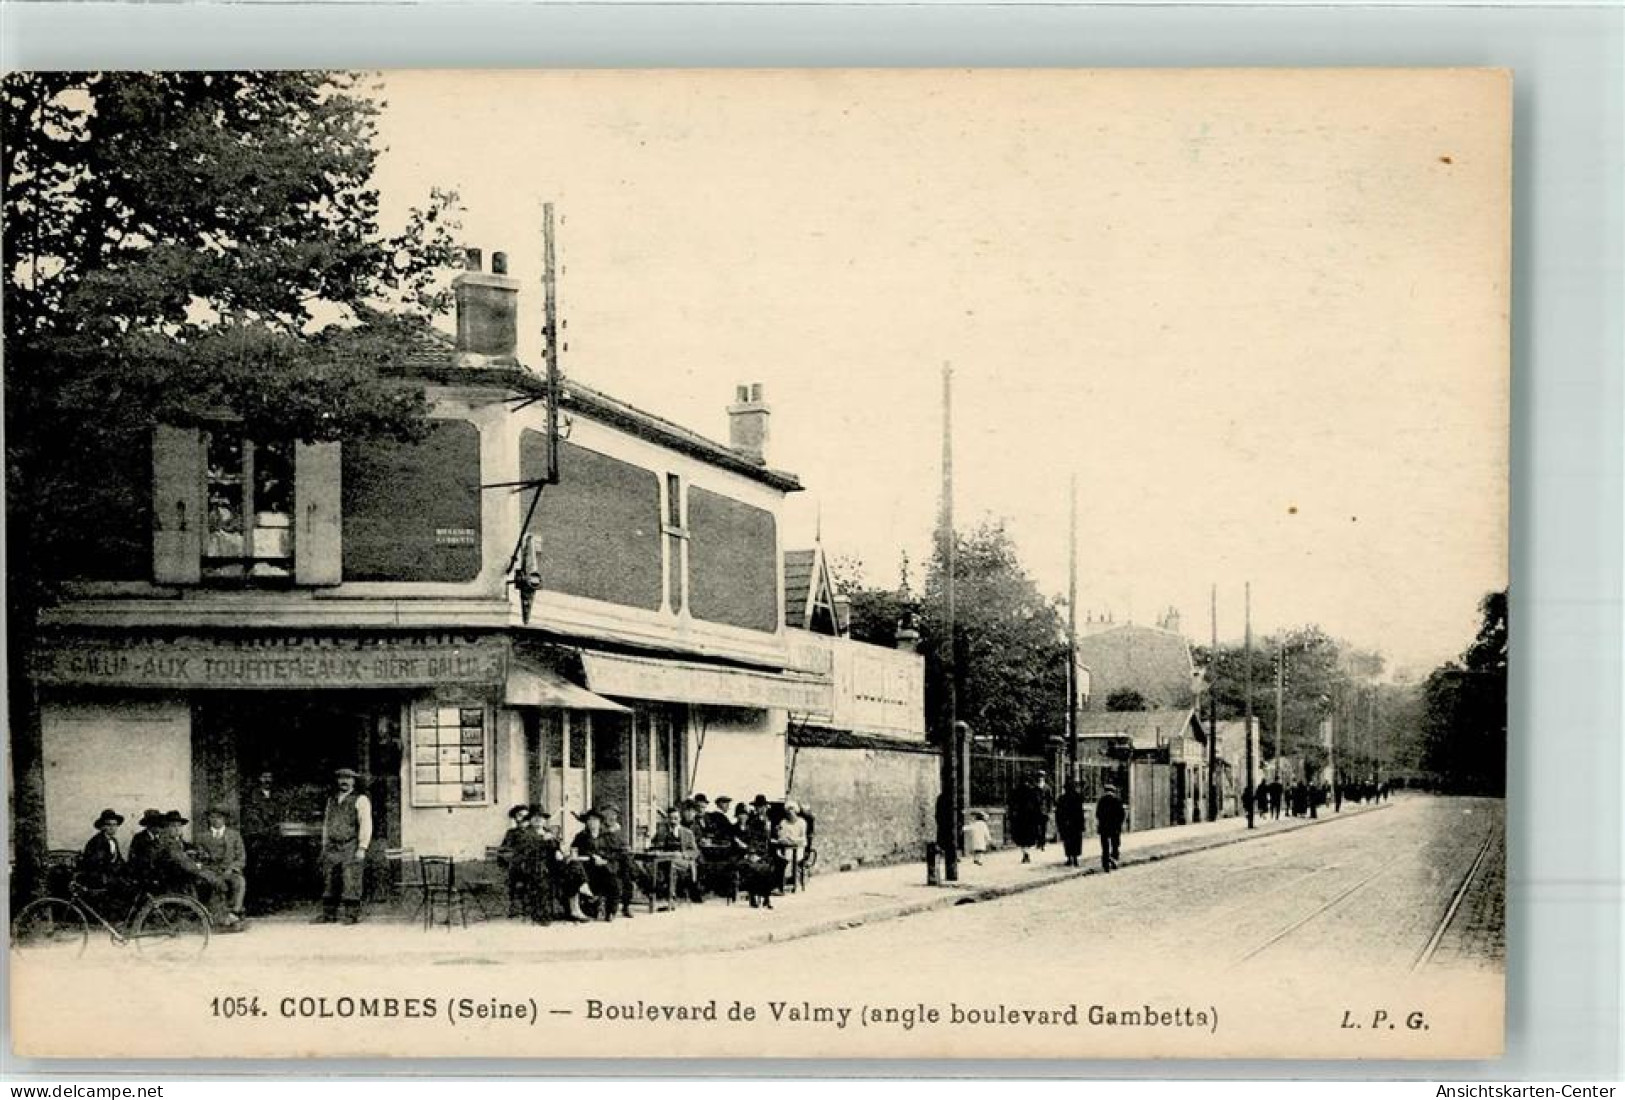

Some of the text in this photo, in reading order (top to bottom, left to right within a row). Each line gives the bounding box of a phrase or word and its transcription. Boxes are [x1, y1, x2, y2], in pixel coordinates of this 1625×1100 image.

[142, 656, 190, 679] AUX
[210, 996, 268, 1019] 1054.
[279, 996, 438, 1019] COLOMBES
[447, 997, 538, 1025] (Seine)
[586, 999, 718, 1021] Boulevard
[727, 1000, 756, 1022] de
[768, 1001, 852, 1029] Valmy
[861, 1002, 940, 1030] (angle
[950, 1003, 1079, 1026] boulevard
[1340, 1010, 1430, 1031] L. P. G.
